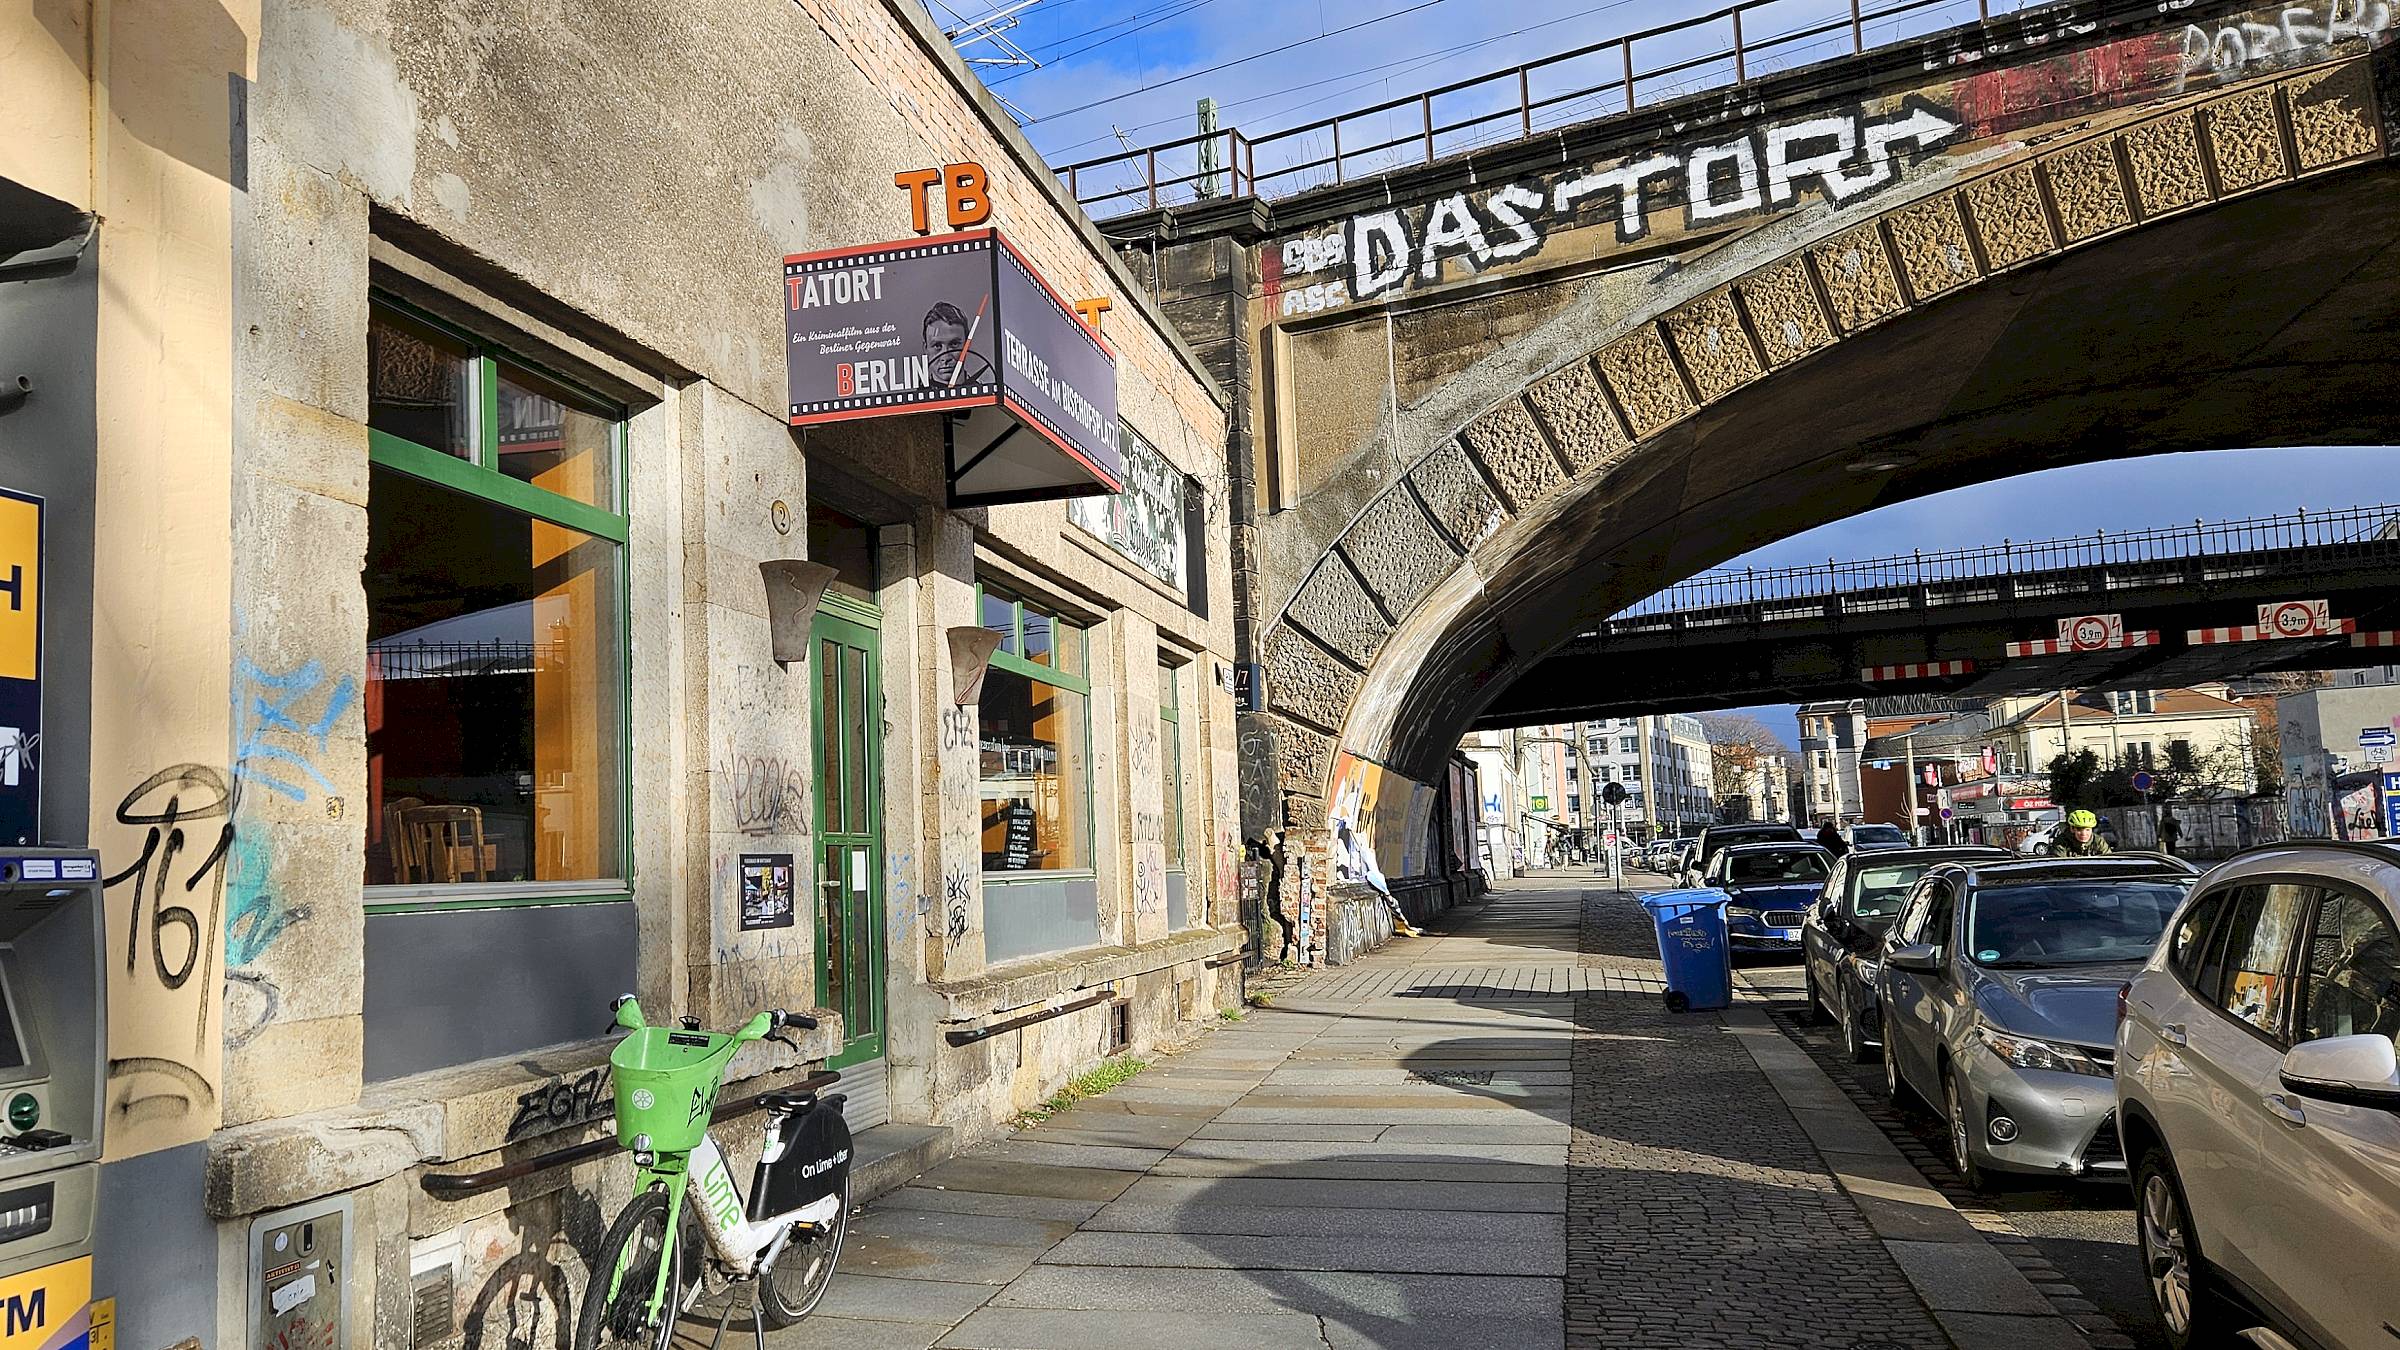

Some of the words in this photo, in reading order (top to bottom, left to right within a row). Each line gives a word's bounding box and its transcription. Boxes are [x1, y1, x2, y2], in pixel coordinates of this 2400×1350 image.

[895, 162, 992, 234] TB
[1347, 176, 1544, 302] DAS
[786, 266, 885, 311] TATORT
[792, 332, 807, 344] Ein
[808, 325, 862, 342] Kriminalfilm
[864, 327, 880, 336] aus
[881, 322, 896, 333] der
[819, 341, 854, 355] Berliner
[854, 337, 902, 355] Gegenwart
[836, 354, 930, 397] BERLIN
[1004, 328, 1050, 398] TERRASSE
[1051, 377, 1062, 407] AM
[1061, 380, 1117, 453] BISCHOFSPLATZ
[1787, 930, 1800, 939] BZ
[801, 1164, 816, 1179] On
[815, 1156, 833, 1174] Lime
[836, 1148, 849, 1165] Uber
